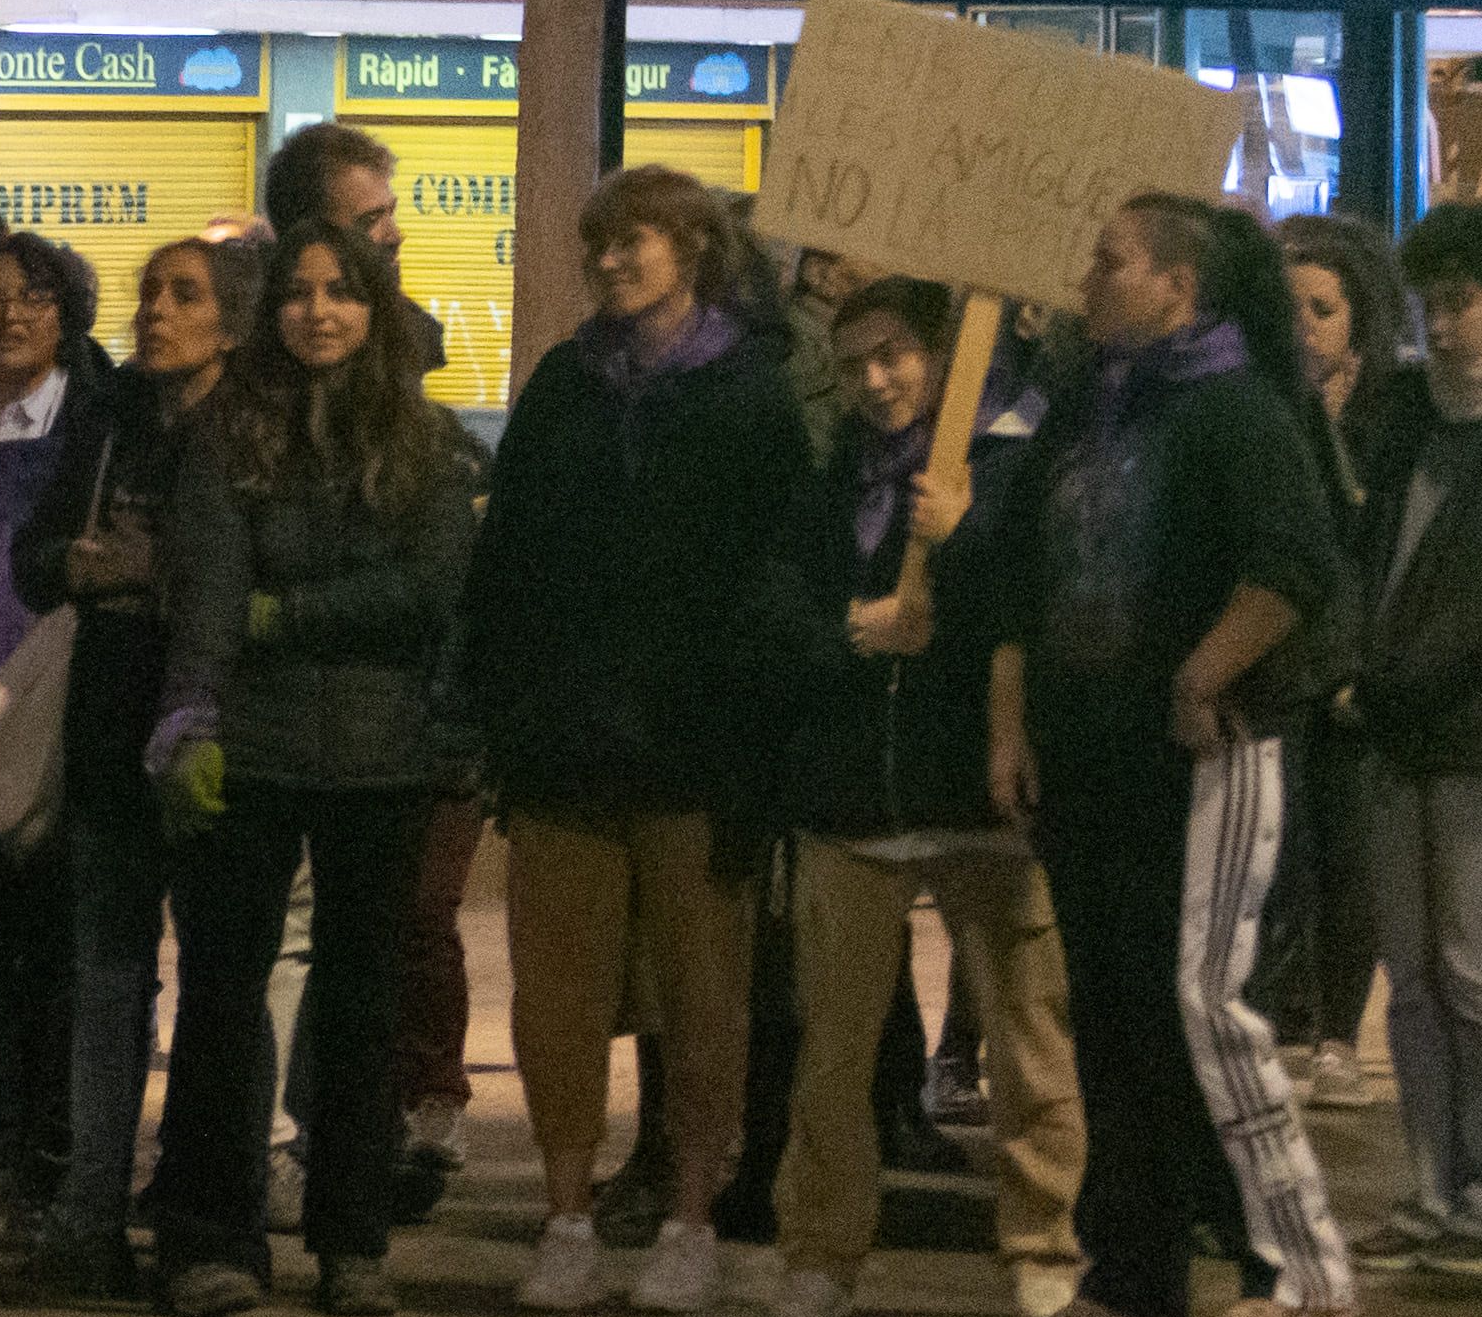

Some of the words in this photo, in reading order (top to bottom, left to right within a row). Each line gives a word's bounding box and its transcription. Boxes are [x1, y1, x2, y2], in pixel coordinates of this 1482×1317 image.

[75, 42, 156, 82] Cash
[359, 53, 439, 93] Ràpid
[626, 63, 670, 95] gur
[784, 150, 874, 229] NO
[928, 122, 1123, 221] AMIGUE
